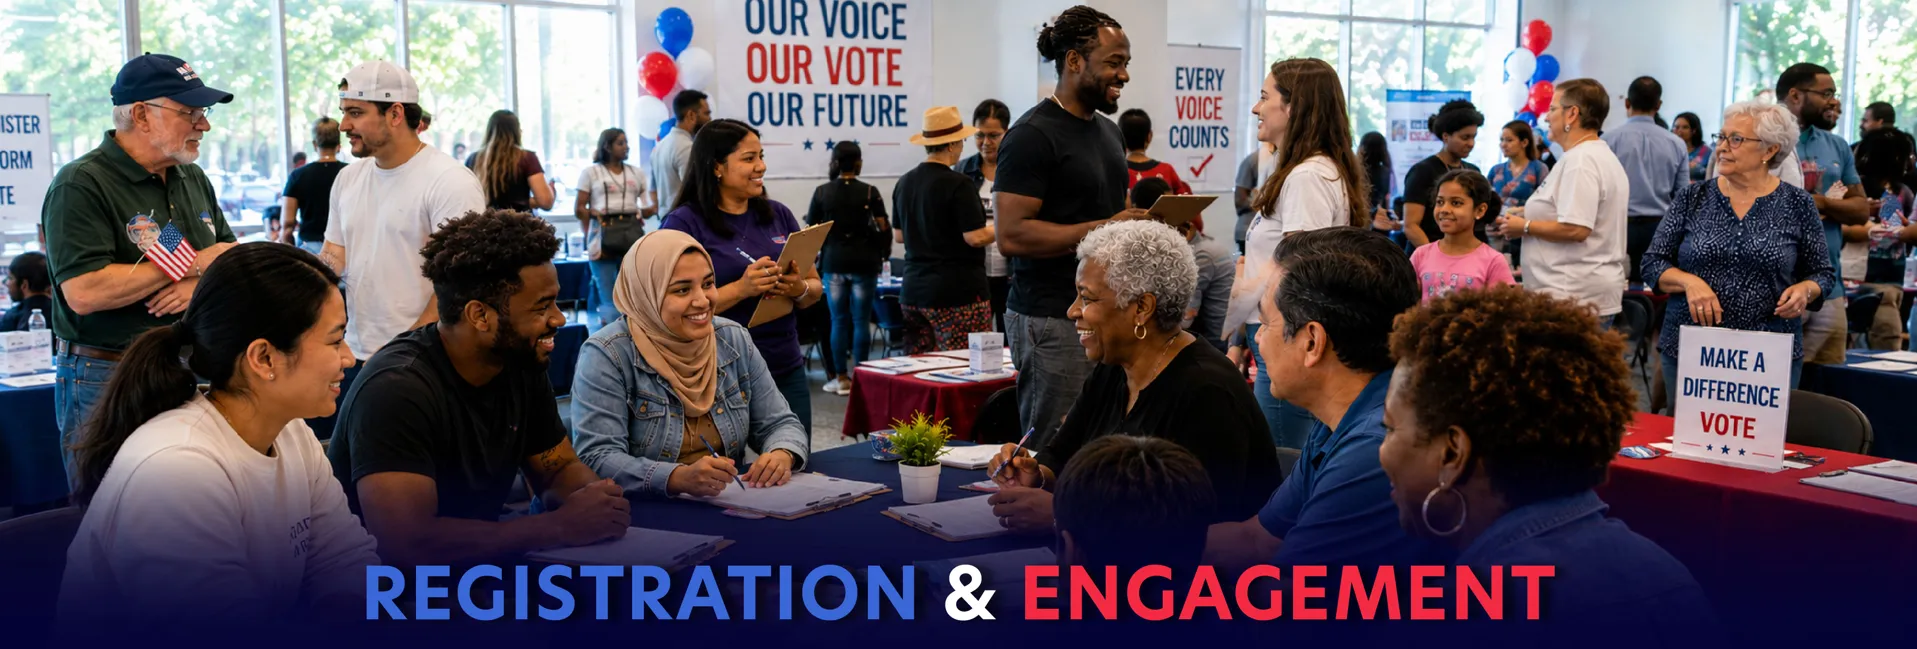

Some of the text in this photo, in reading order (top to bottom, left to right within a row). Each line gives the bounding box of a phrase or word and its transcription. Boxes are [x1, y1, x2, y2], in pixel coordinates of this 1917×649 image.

[745, 0, 907, 40] OUR VOICE
[747, 41, 903, 87] OUR VOTE
[1175, 66, 1225, 92] EVERY
[747, 91, 908, 127] OUR FUTURE
[1175, 95, 1223, 121] VOICE
[1169, 125, 1229, 149] COUNTS
[1700, 346, 1766, 373] MAKE A
[1683, 377, 1781, 408] DIFFERENCE
[1700, 411, 1757, 439] VOTE
